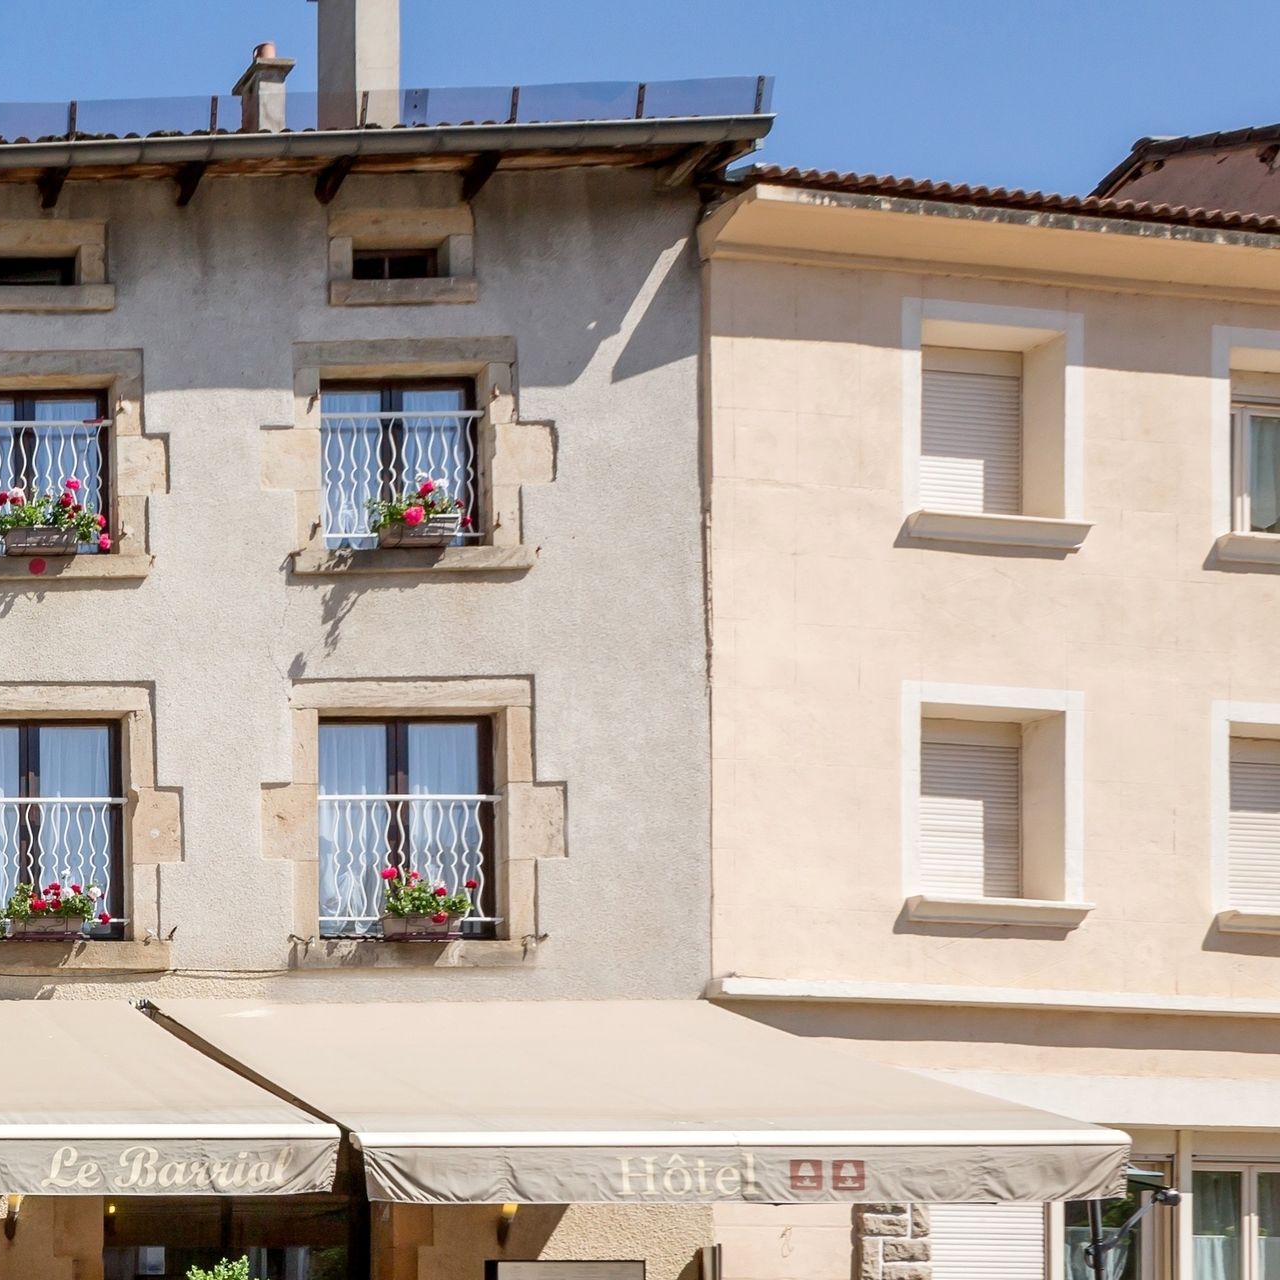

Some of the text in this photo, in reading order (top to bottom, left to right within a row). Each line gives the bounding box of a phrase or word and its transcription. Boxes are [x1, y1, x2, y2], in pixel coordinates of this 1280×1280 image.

[41, 1145, 295, 1188] Le Barriol
[616, 1153, 761, 1195] Hôtel
